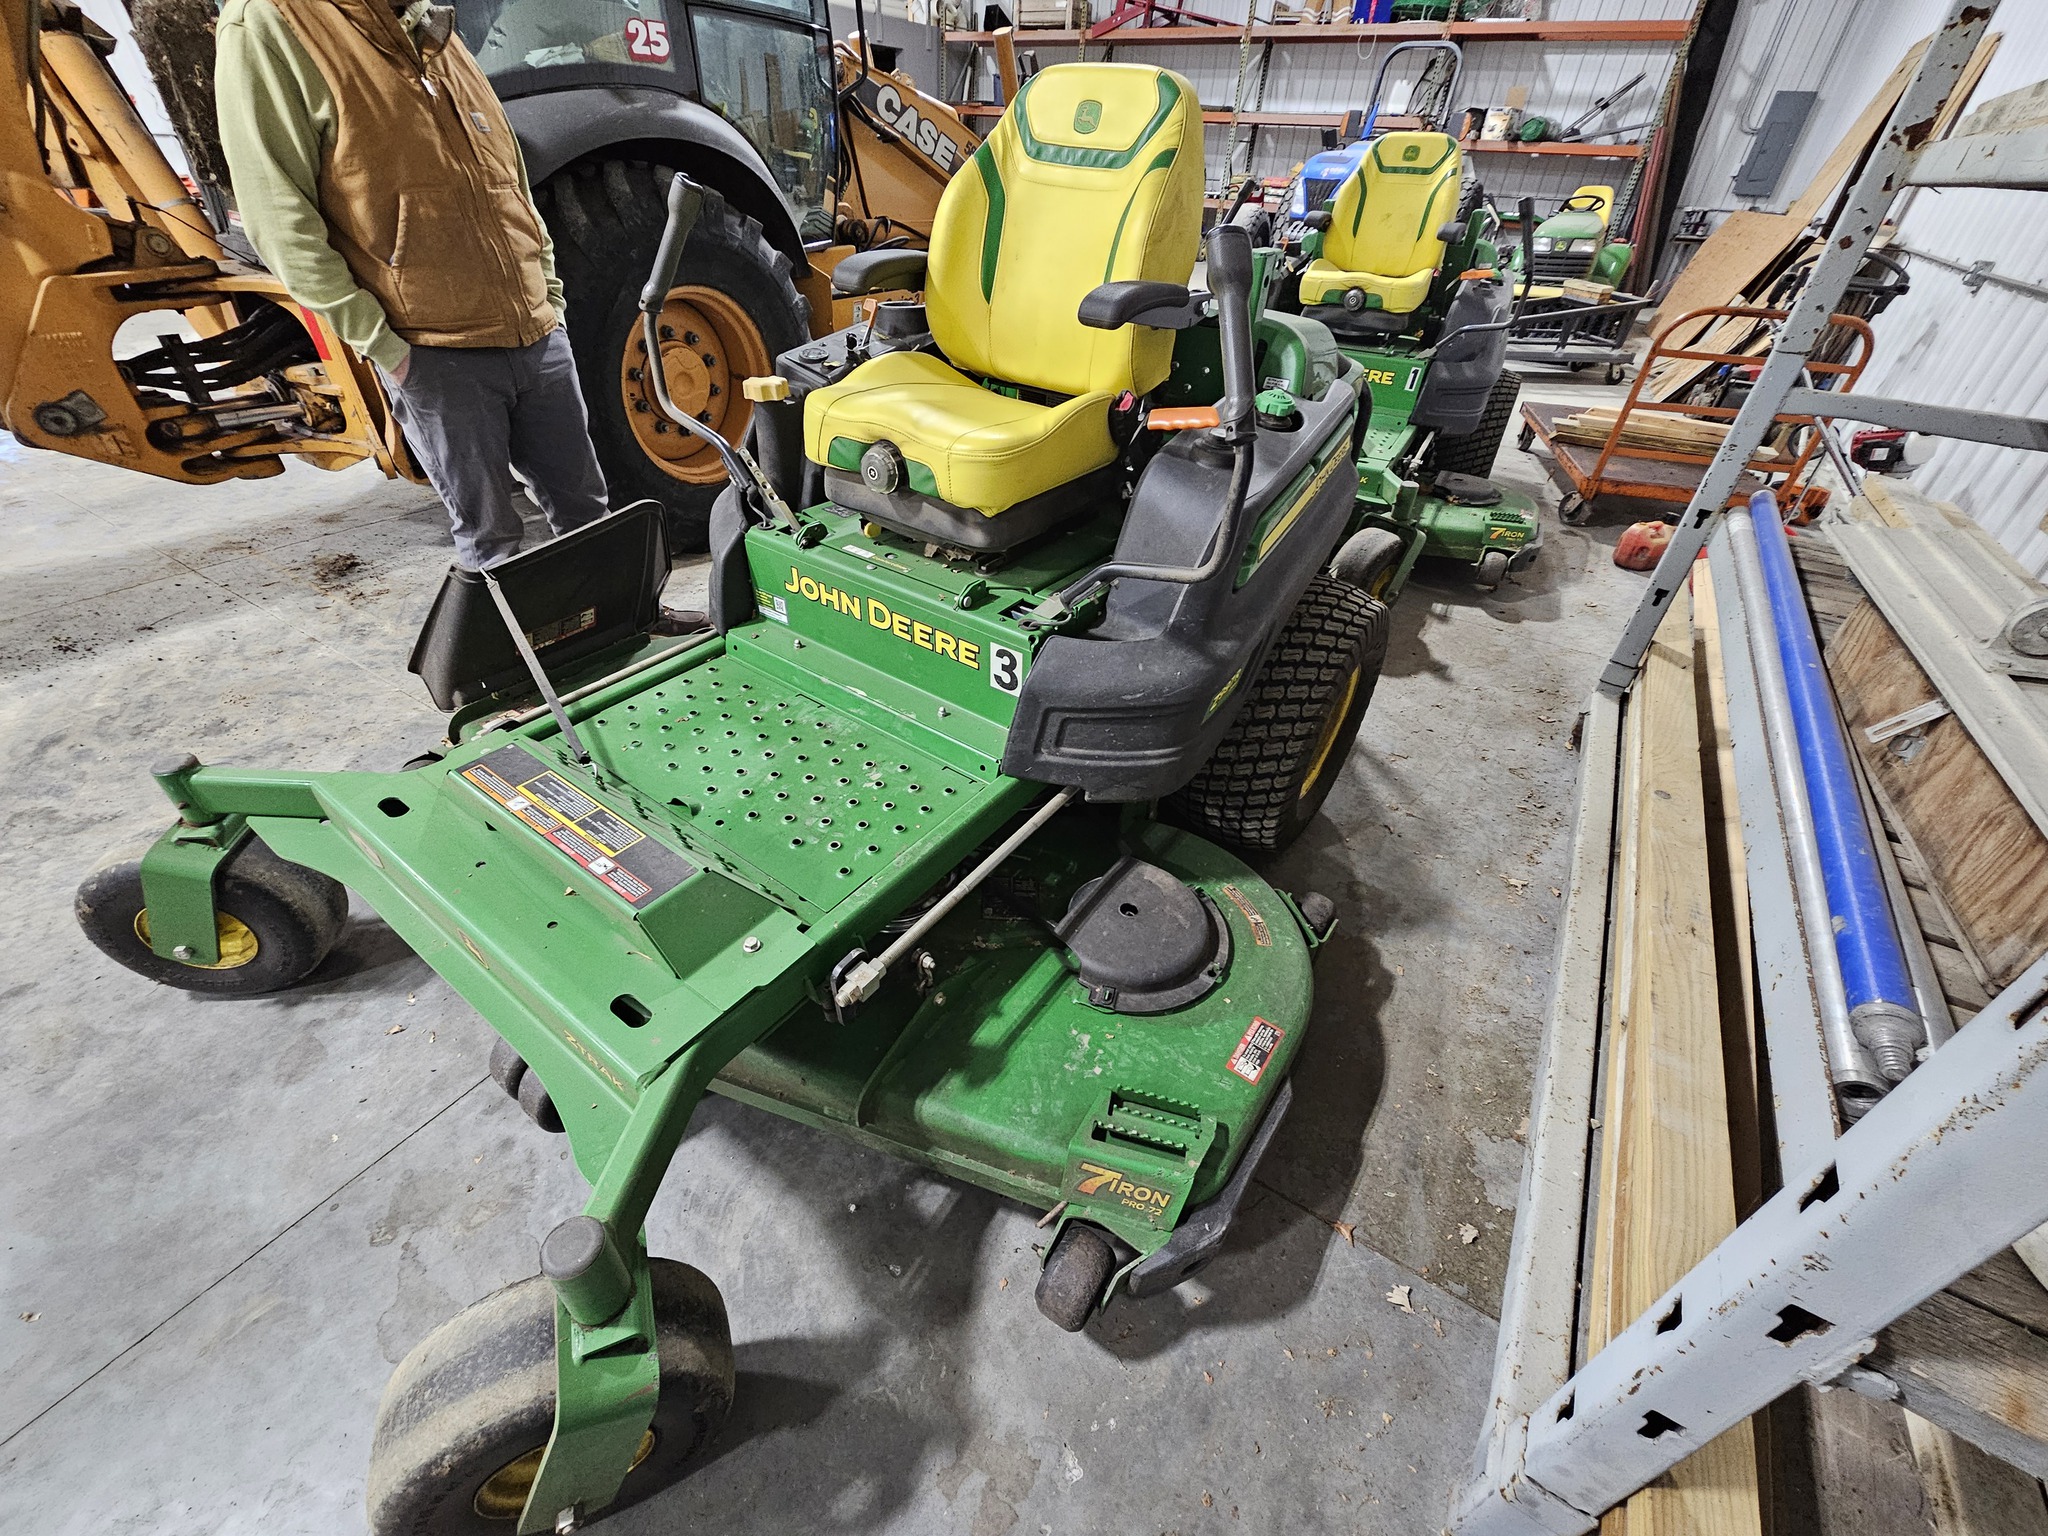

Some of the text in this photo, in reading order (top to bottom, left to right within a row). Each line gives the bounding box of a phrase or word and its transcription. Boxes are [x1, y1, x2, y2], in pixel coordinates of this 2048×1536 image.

[627, 19, 670, 57] 25
[876, 84, 958, 172] CASE
[1408, 368, 1420, 390] 1
[784, 565, 863, 621] JOHN
[866, 596, 981, 671] DEERE
[993, 648, 1019, 691] 3
[1121, 1198, 1164, 1217] PRO 72
